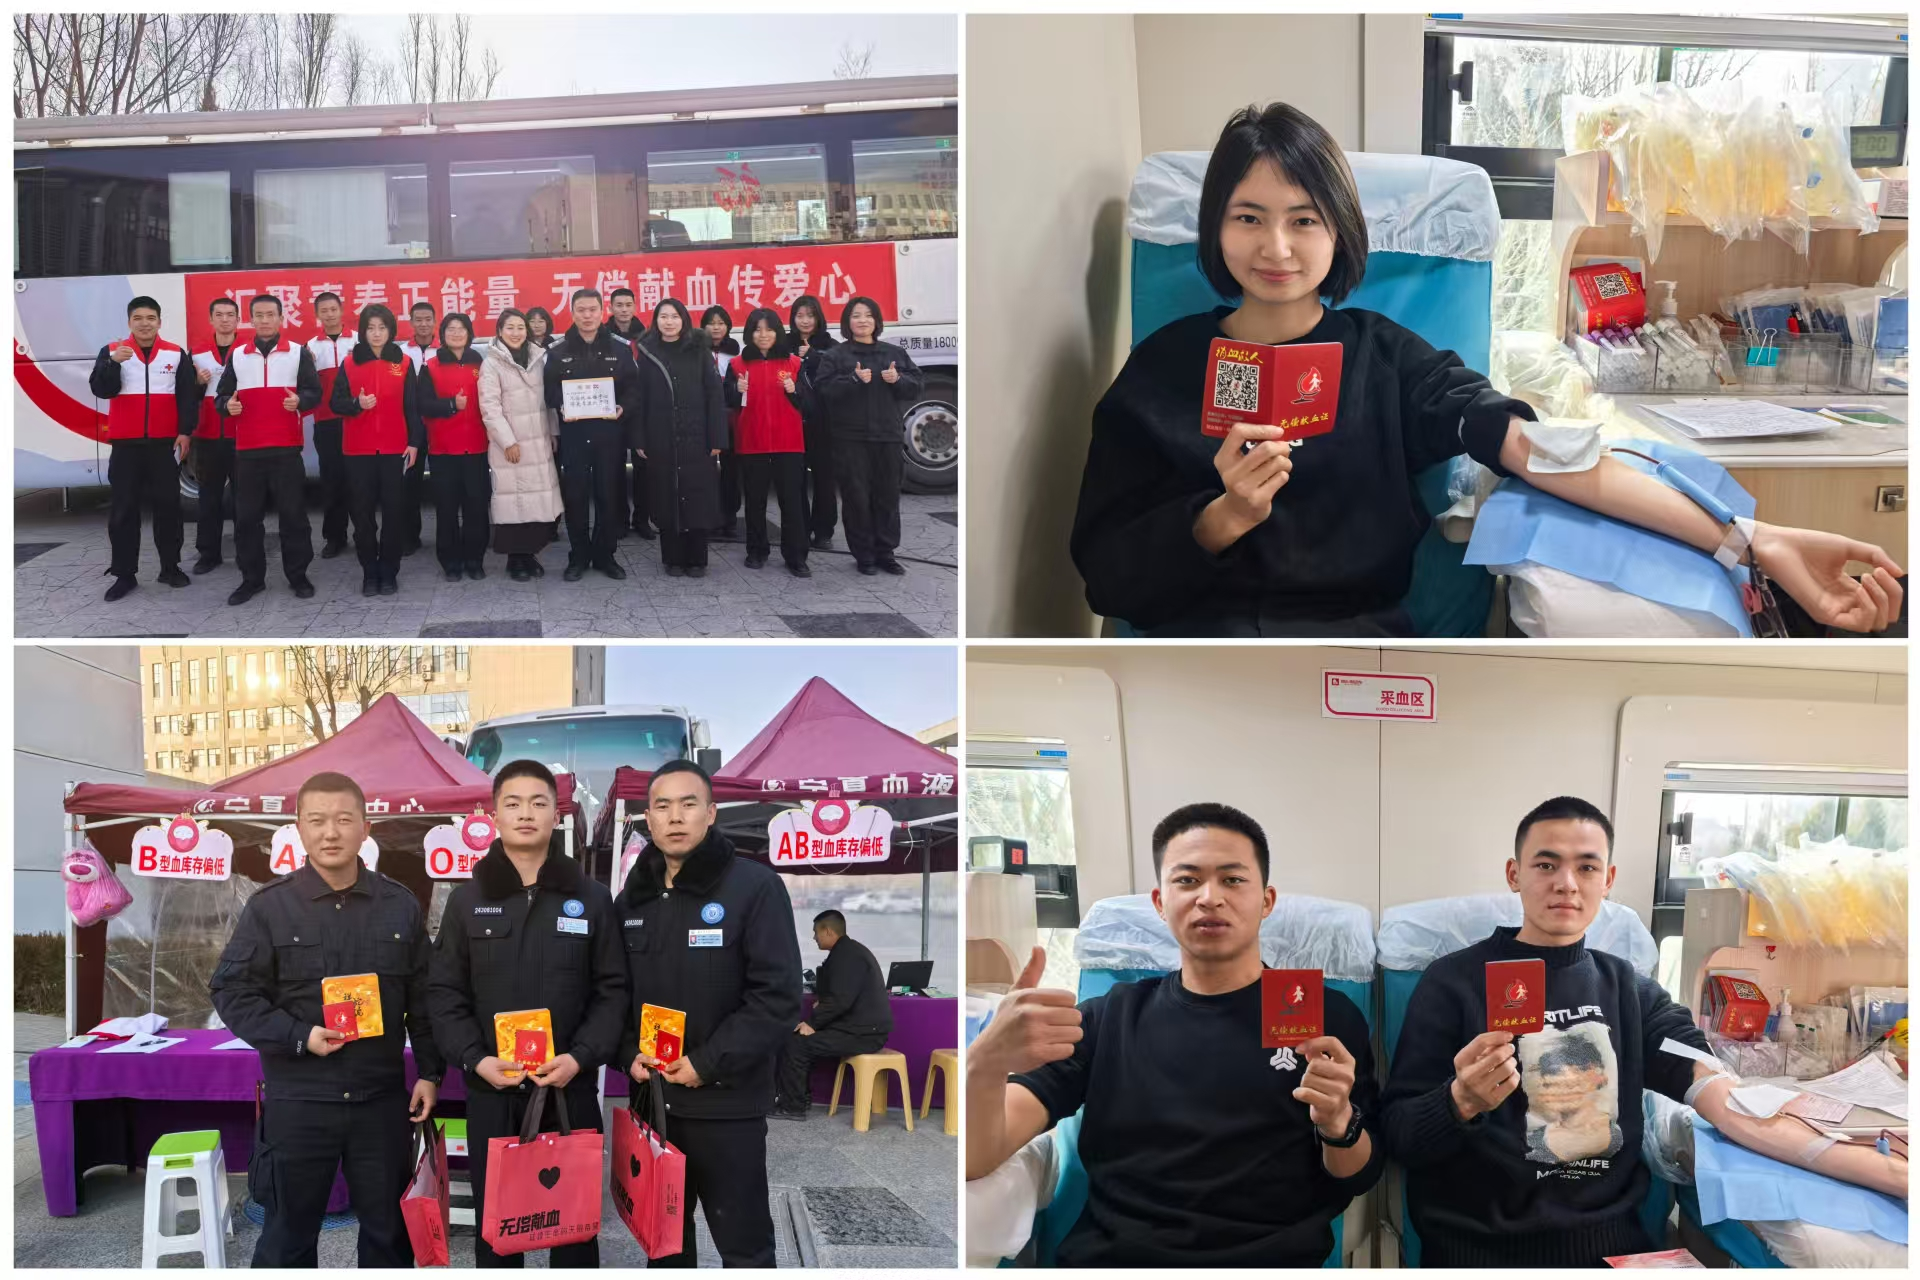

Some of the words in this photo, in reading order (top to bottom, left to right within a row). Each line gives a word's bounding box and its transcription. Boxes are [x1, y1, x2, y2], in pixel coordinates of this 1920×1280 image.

[551, 261, 857, 316] 无偿献血传爱心
[900, 335, 958, 350] 总质量1800
[1281, 412, 1329, 429] 无偿献血证
[1380, 690, 1425, 706] 采血区
[777, 831, 883, 860] AB型血库存偏低
[138, 845, 225, 876] B型血库存偏低
[430, 847, 485, 875] O型血
[1271, 1025, 1317, 1034] 无偿献血证
[1494, 1016, 1537, 1027] 无偿献血证
[499, 1209, 560, 1237] 无偿献血
